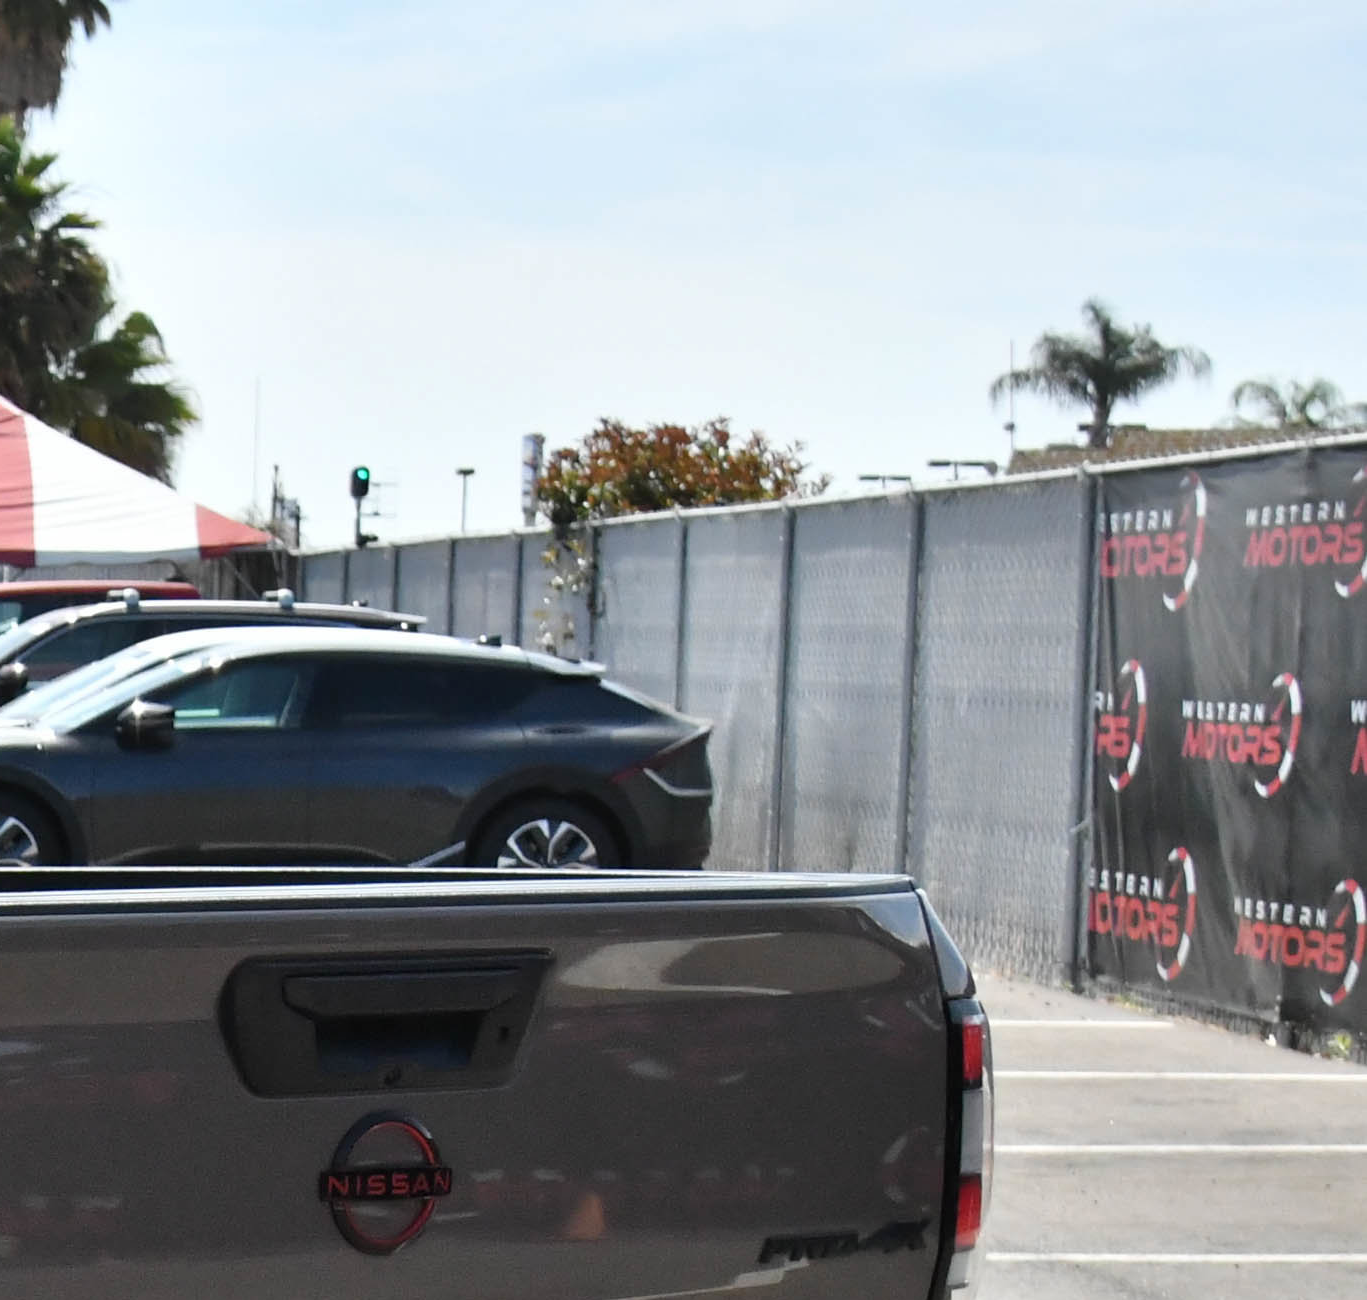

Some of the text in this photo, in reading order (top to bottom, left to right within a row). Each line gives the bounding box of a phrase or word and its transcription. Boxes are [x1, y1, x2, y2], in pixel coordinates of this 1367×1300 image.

[1246, 500, 1346, 527] WESTERN
[1243, 521, 1364, 568] MOTORS
[1181, 719, 1282, 766] MOTORS
[1234, 916, 1347, 975] MOTORS
[327, 1170, 451, 1198] NISSAN
